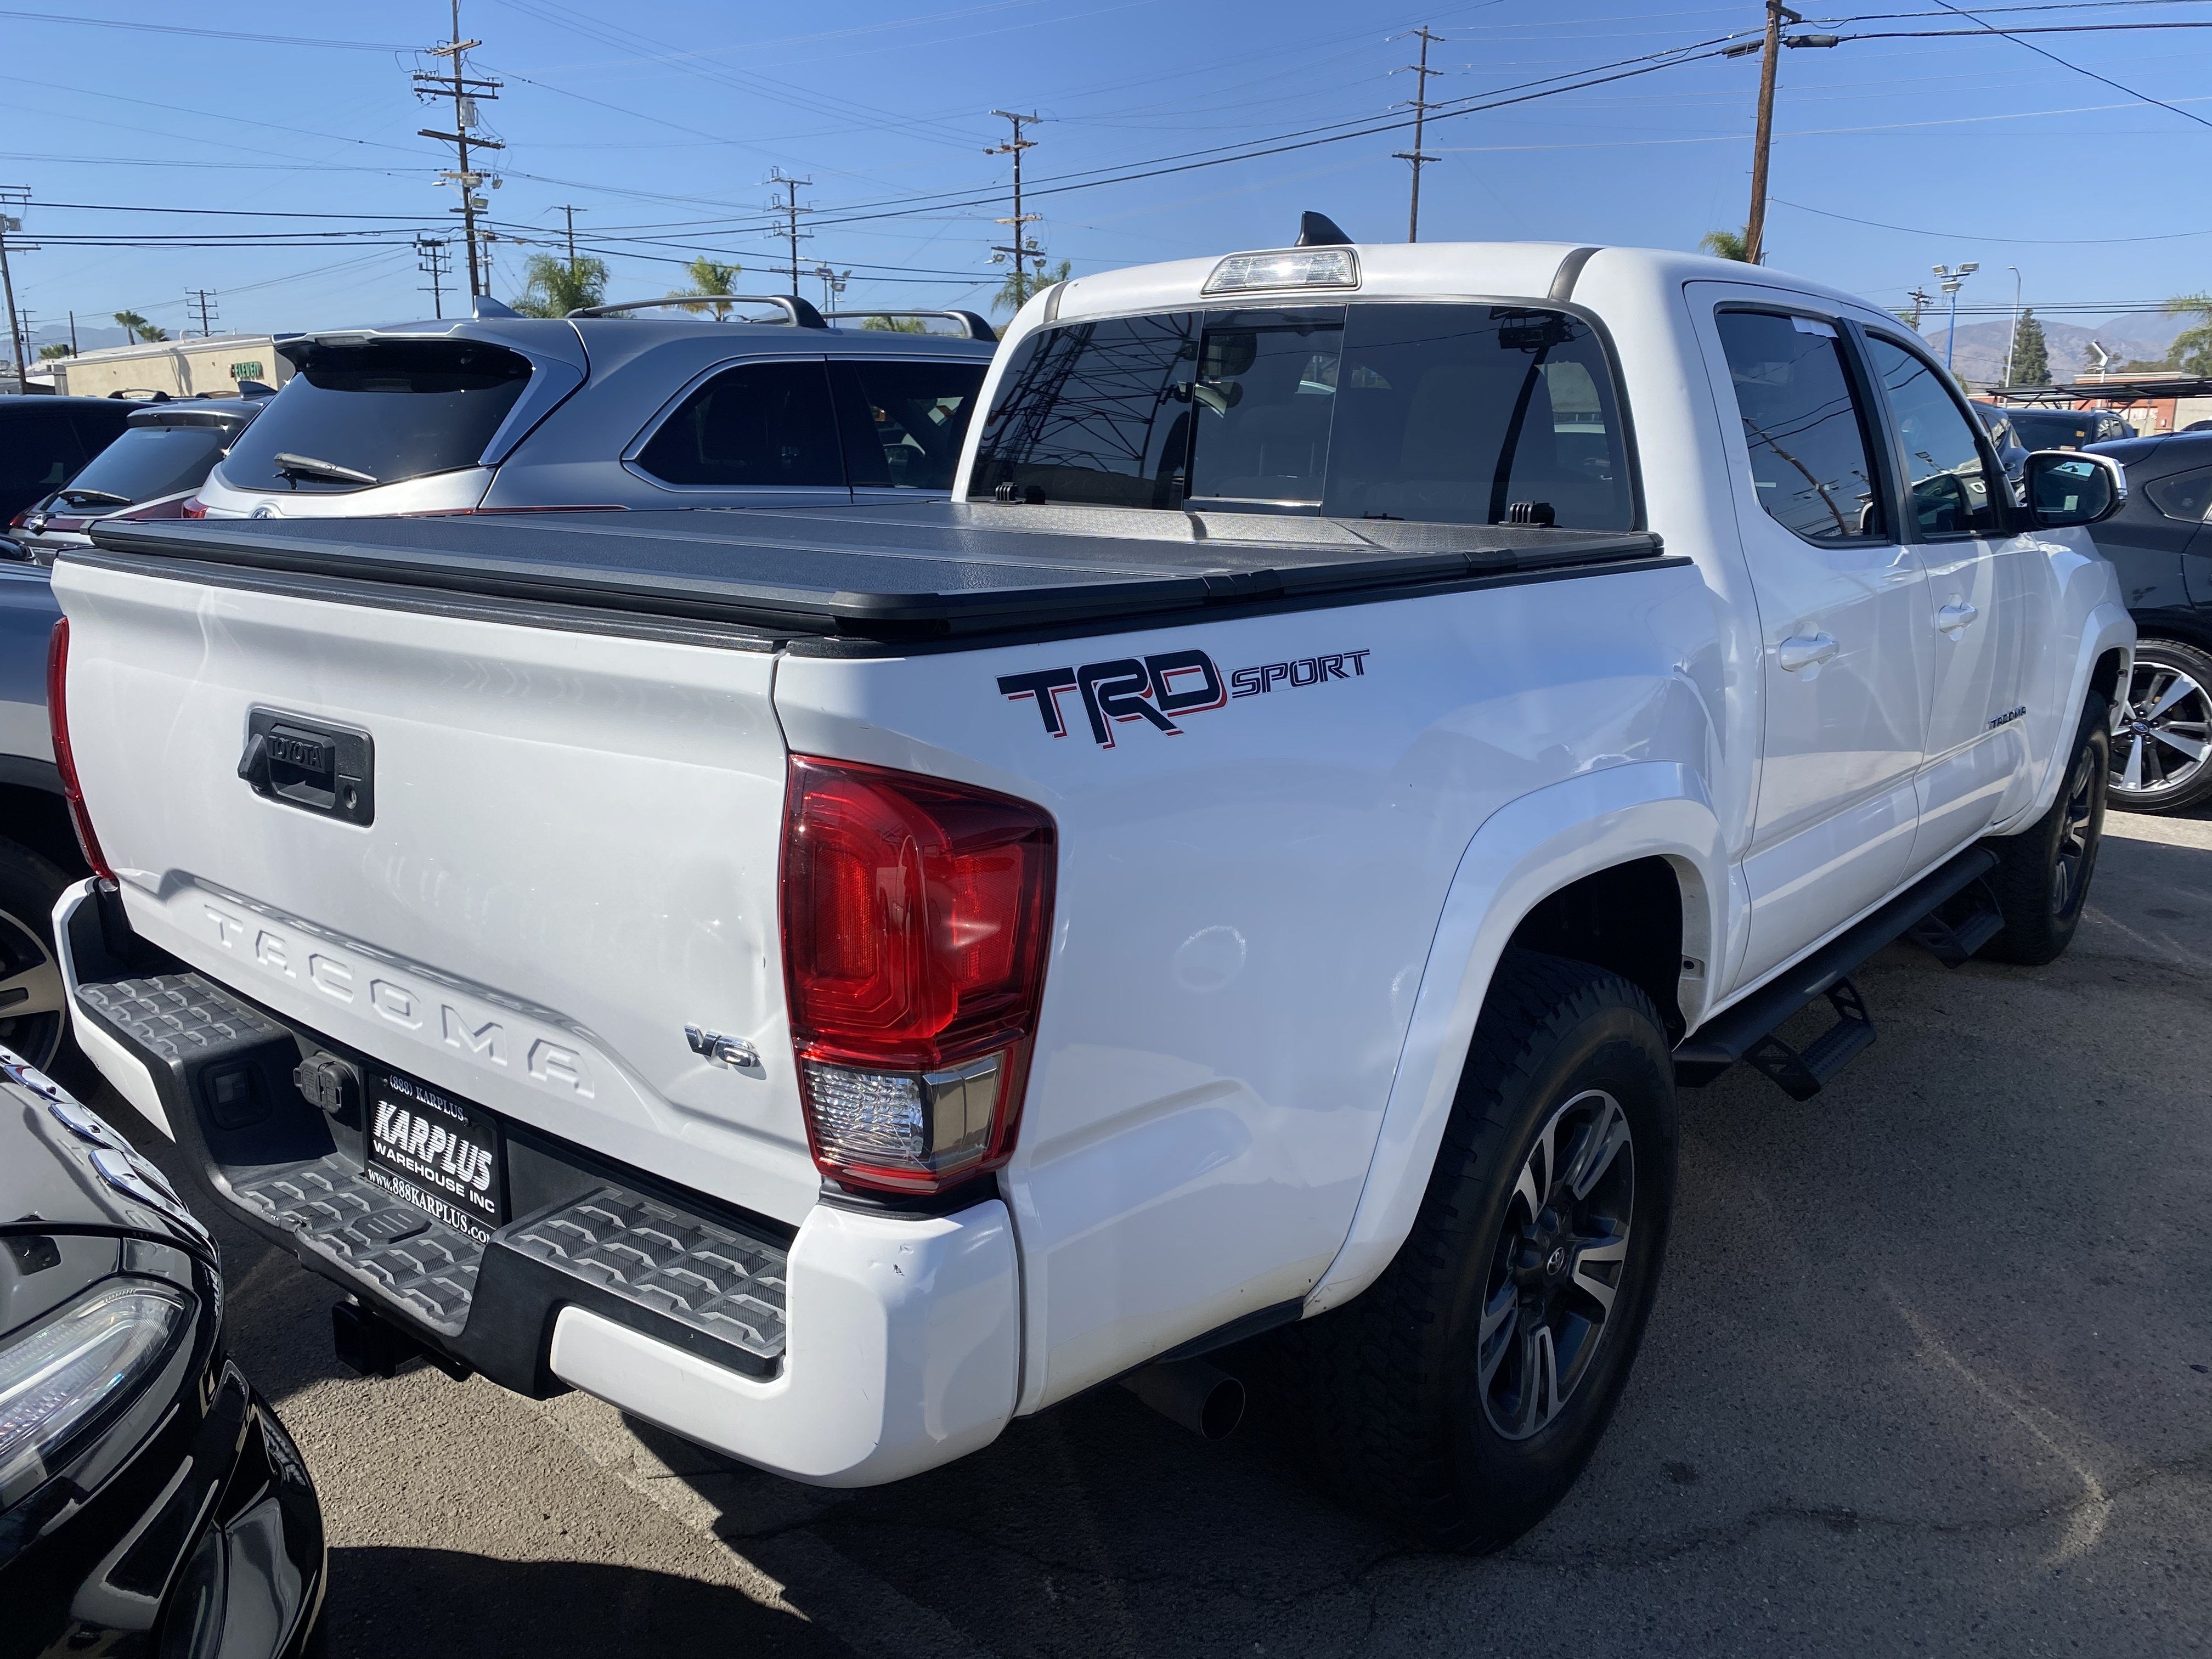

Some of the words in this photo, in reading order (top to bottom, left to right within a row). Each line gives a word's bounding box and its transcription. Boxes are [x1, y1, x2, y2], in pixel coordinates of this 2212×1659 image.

[996, 649, 1227, 749] TRD
[1231, 649, 1370, 699] SPORT
[1988, 706, 2027, 729] TACOMA
[269, 736, 324, 769] TOYOTA
[204, 904, 595, 1099] TACOMA
[684, 1022, 760, 1068] V6
[390, 1074, 413, 1097] (888)
[415, 1086, 464, 1122] KARPLUS
[373, 1100, 493, 1191] KARPLUS
[373, 1139, 465, 1198] WAREHOUSE
[470, 1189, 495, 1214] INC
